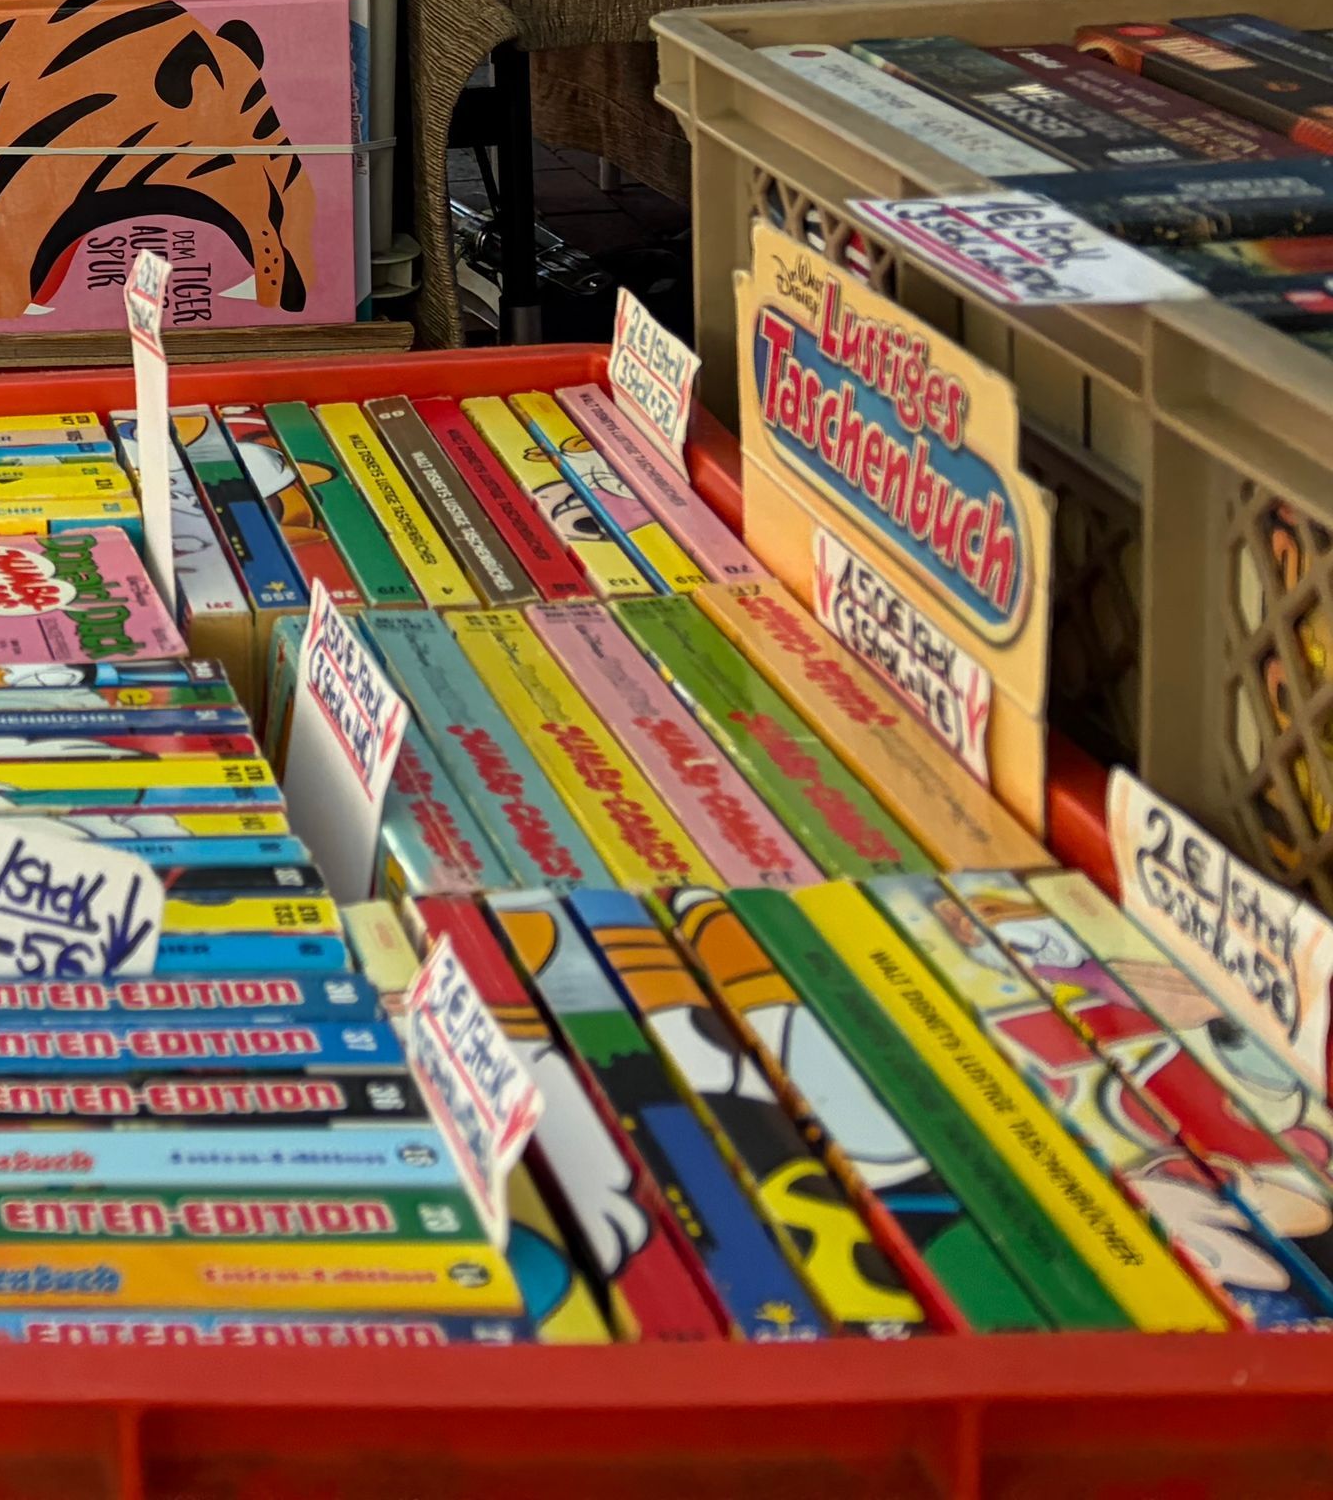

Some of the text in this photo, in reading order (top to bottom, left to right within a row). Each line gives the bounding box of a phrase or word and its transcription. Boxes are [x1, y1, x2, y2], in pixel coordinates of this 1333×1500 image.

[86, 236, 127, 291] SPUR
[173, 231, 212, 326] DEM TIGER
[817, 272, 968, 450] Lustiges
[759, 306, 1016, 613] Taschenbuch
